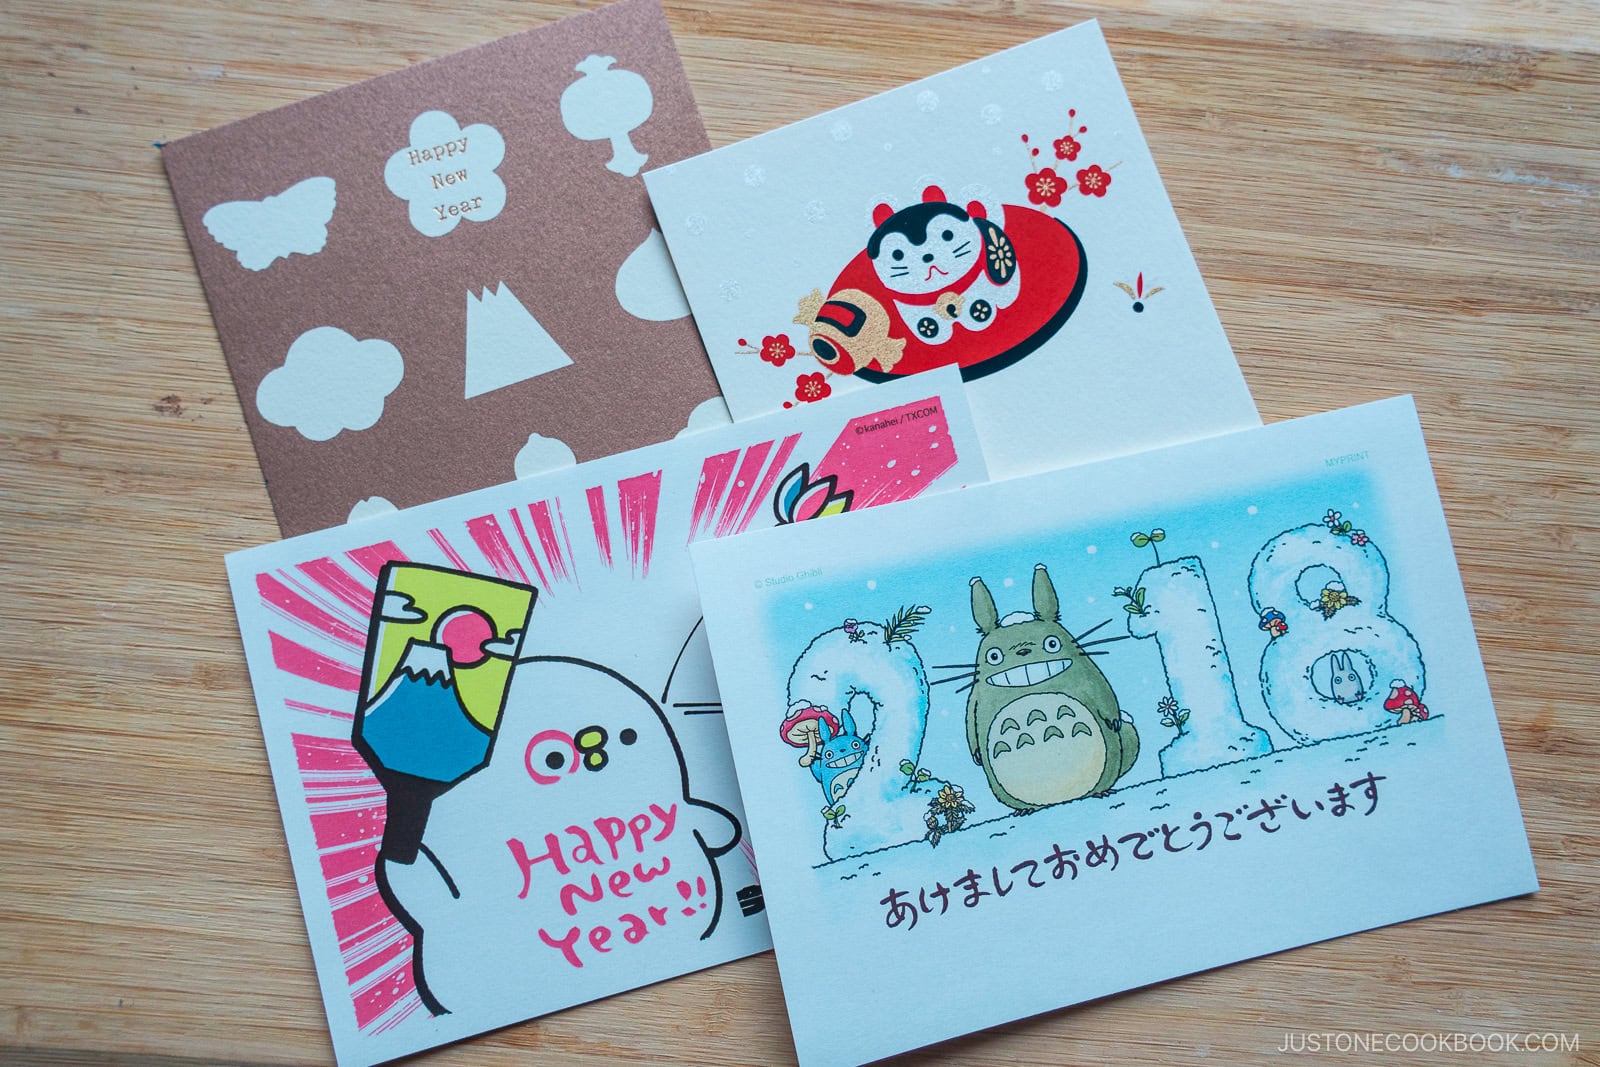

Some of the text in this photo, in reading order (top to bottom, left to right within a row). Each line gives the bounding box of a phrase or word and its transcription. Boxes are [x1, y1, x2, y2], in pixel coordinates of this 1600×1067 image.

[408, 137, 468, 165] Happy
[431, 169, 468, 189] New
[433, 196, 482, 221] Year
[506, 803, 677, 900] Happy
[880, 772, 1386, 930] あけましておめでとうございます
[559, 856, 671, 916] New
